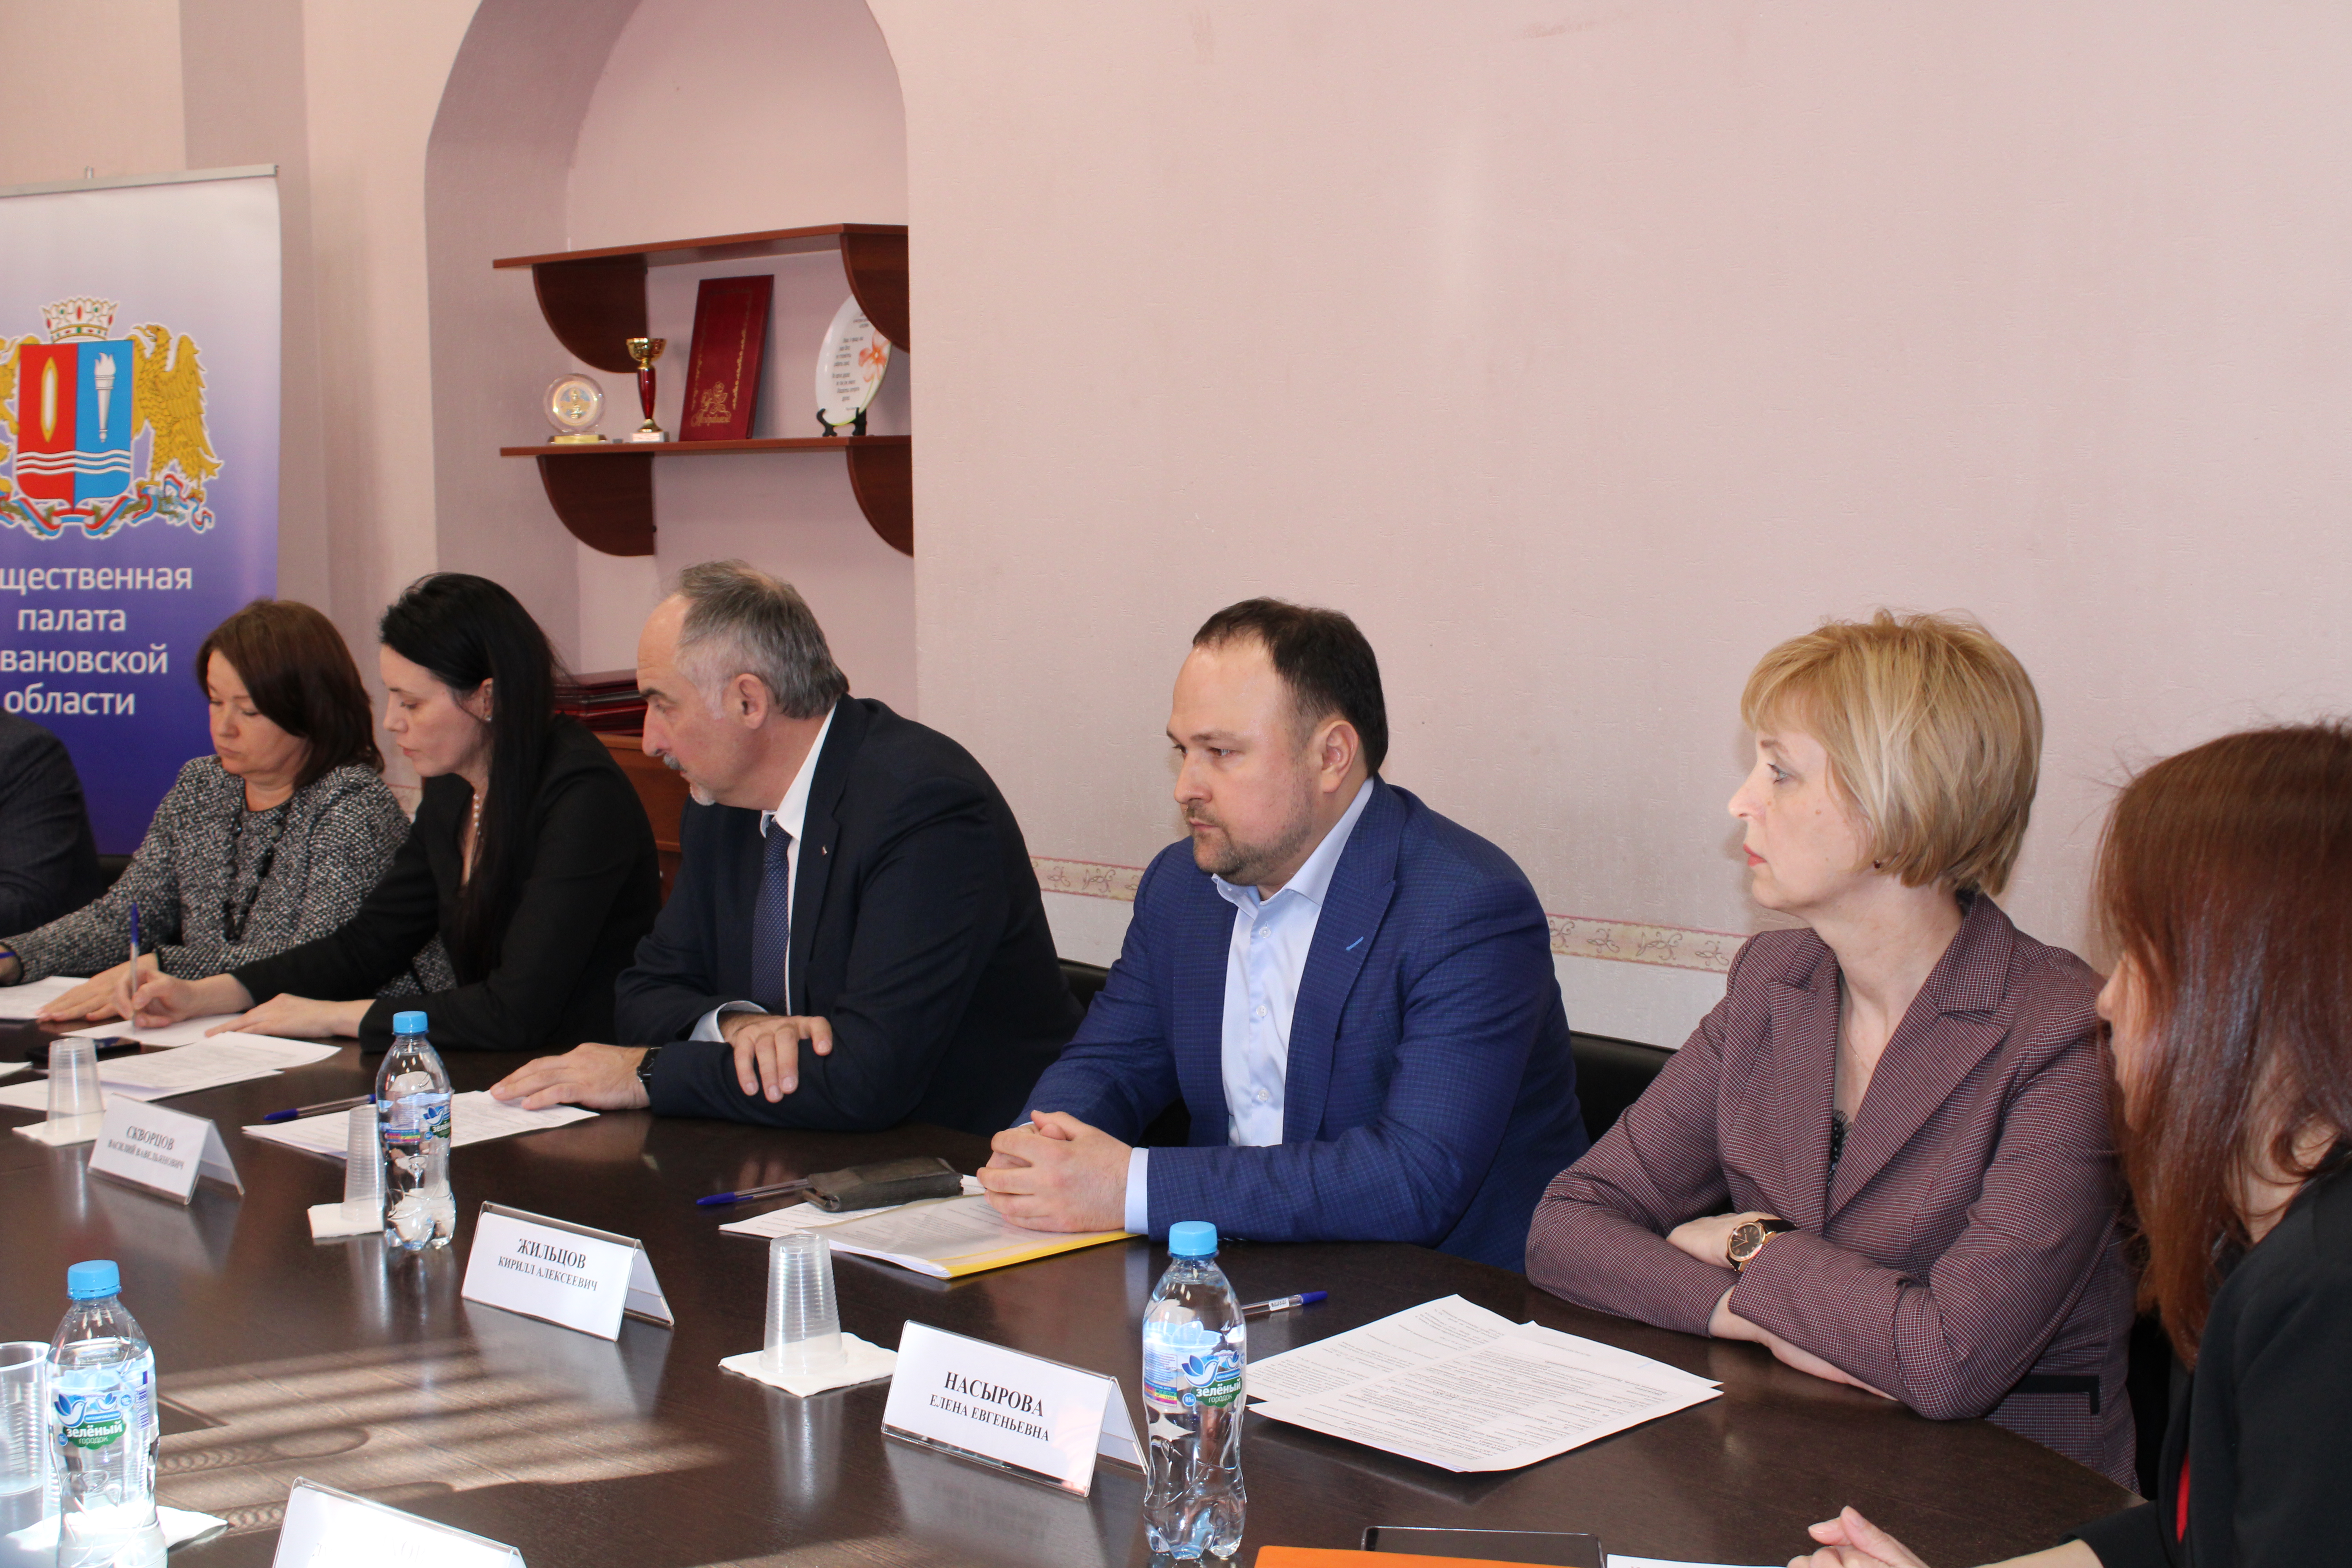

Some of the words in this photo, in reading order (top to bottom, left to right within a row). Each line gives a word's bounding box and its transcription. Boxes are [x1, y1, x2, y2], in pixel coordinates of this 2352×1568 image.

[0, 568, 192, 595] щественная
[18, 608, 126, 632] палата
[0, 643, 168, 674] вановской
[4, 682, 135, 715] области
[107, 1138, 136, 1154] ВАСИЛИЙ
[126, 1125, 175, 1150] СКВОРЦОВ
[517, 1238, 586, 1269] ЖИЛЬЦОВ
[498, 1256, 536, 1275] КИРИЛЛ
[536, 1267, 598, 1291] АЛЕКСЕЕВИЧ
[944, 1371, 1044, 1417] НАСЫРОВА
[1196, 1377, 1241, 1397] зелёный
[1208, 1394, 1232, 1404] городок
[66, 1420, 122, 1437] зелёный
[929, 1394, 968, 1416] ЕЛЕНА
[971, 1406, 1049, 1442] ЕВГЕНЬЕВНА
[78, 1436, 109, 1446] городок
